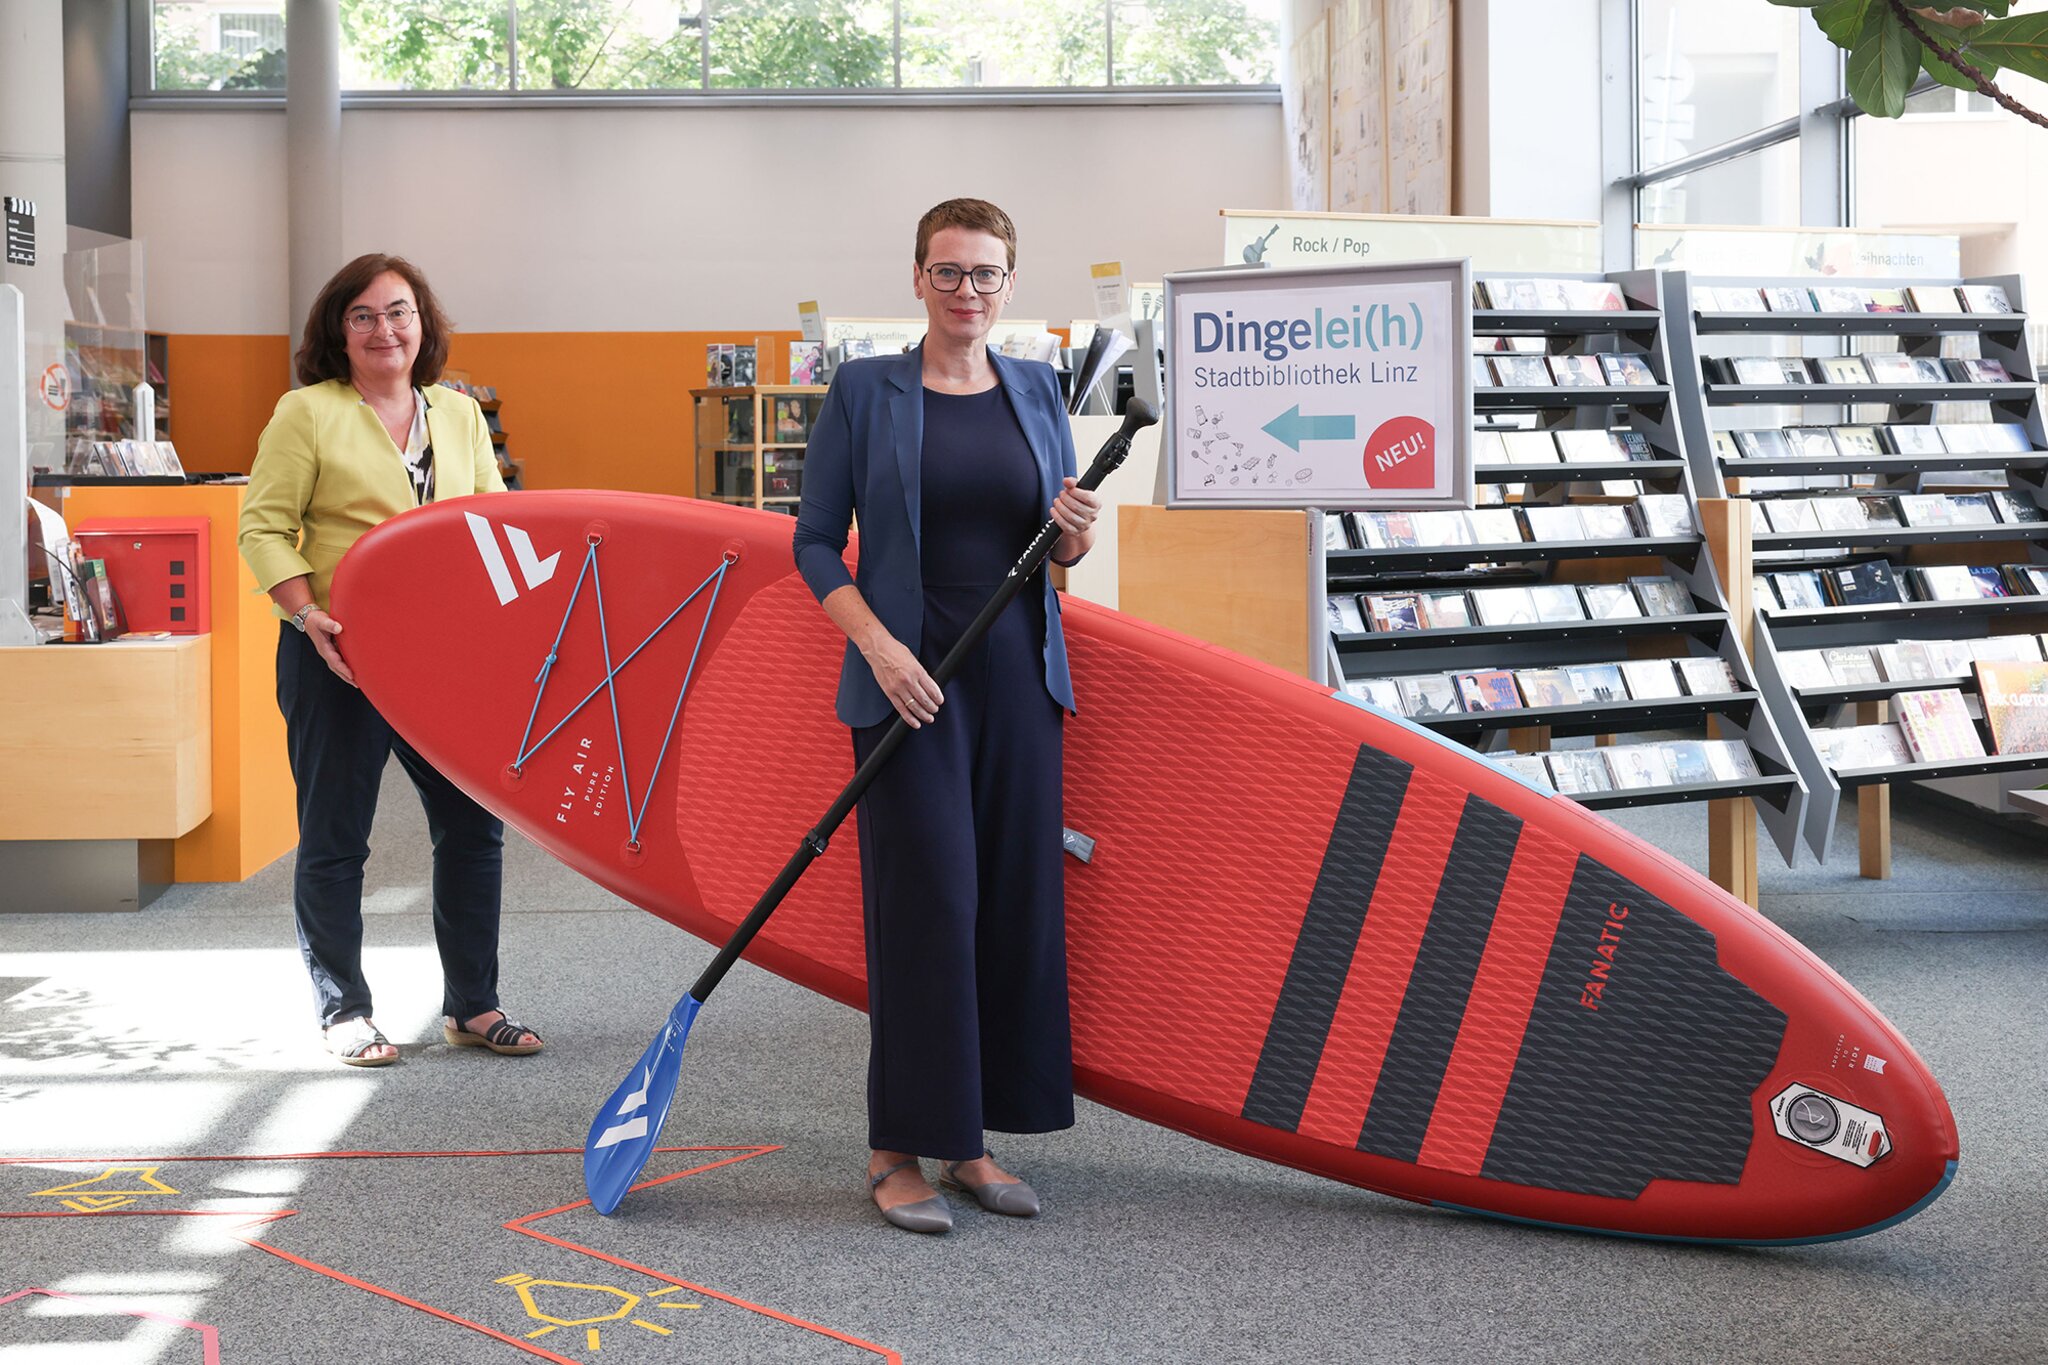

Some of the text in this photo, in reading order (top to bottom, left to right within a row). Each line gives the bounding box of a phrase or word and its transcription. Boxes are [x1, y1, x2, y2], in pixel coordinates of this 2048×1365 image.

[1292, 236, 1328, 252] Rock
[1343, 238, 1371, 257] Pop
[864, 331, 908, 342] Actionfilm
[1193, 302, 1424, 362] Dingelei(h)
[1194, 361, 1419, 388] Stadtbibliothek Linz
[1374, 431, 1427, 473] NEU!
[556, 737, 593, 824] FLY AIR
[584, 771, 599, 802] PURE
[593, 765, 615, 817] EDITION
[1580, 902, 1629, 1011] FANATIC
[1848, 1046, 1860, 1069] RIDE
